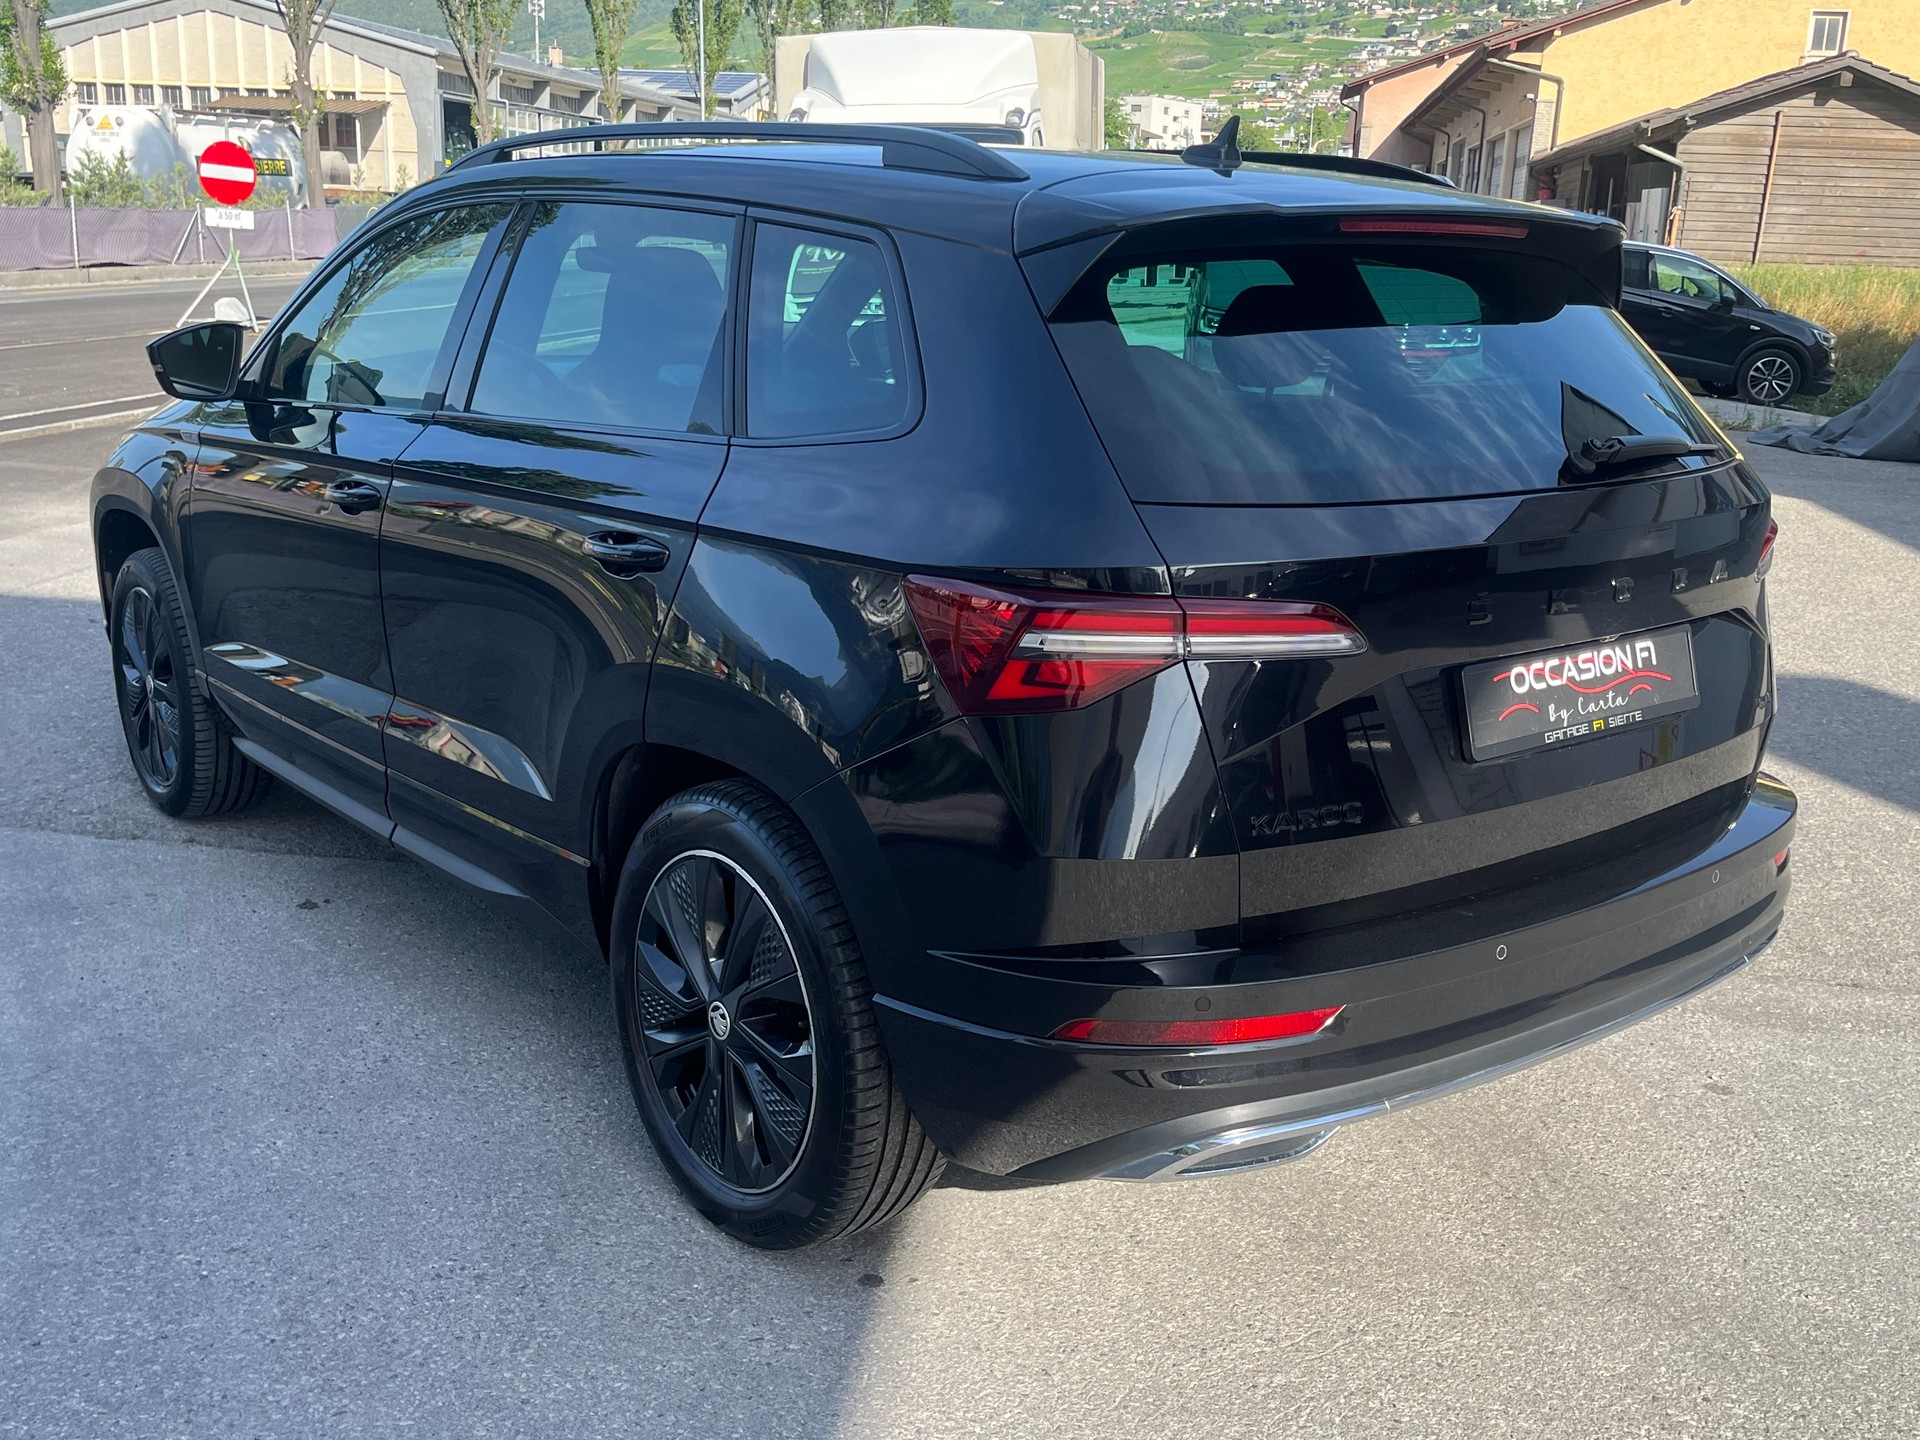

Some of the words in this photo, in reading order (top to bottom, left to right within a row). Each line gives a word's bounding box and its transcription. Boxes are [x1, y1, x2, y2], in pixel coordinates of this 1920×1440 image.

[254, 160, 287, 175] SIERRE
[224, 211, 233, 221] 50
[1510, 643, 1633, 694] OCCASION
[1548, 702, 1574, 727] By
[1577, 690, 1629, 715] Carta
[1250, 801, 1364, 836] KAROQ
